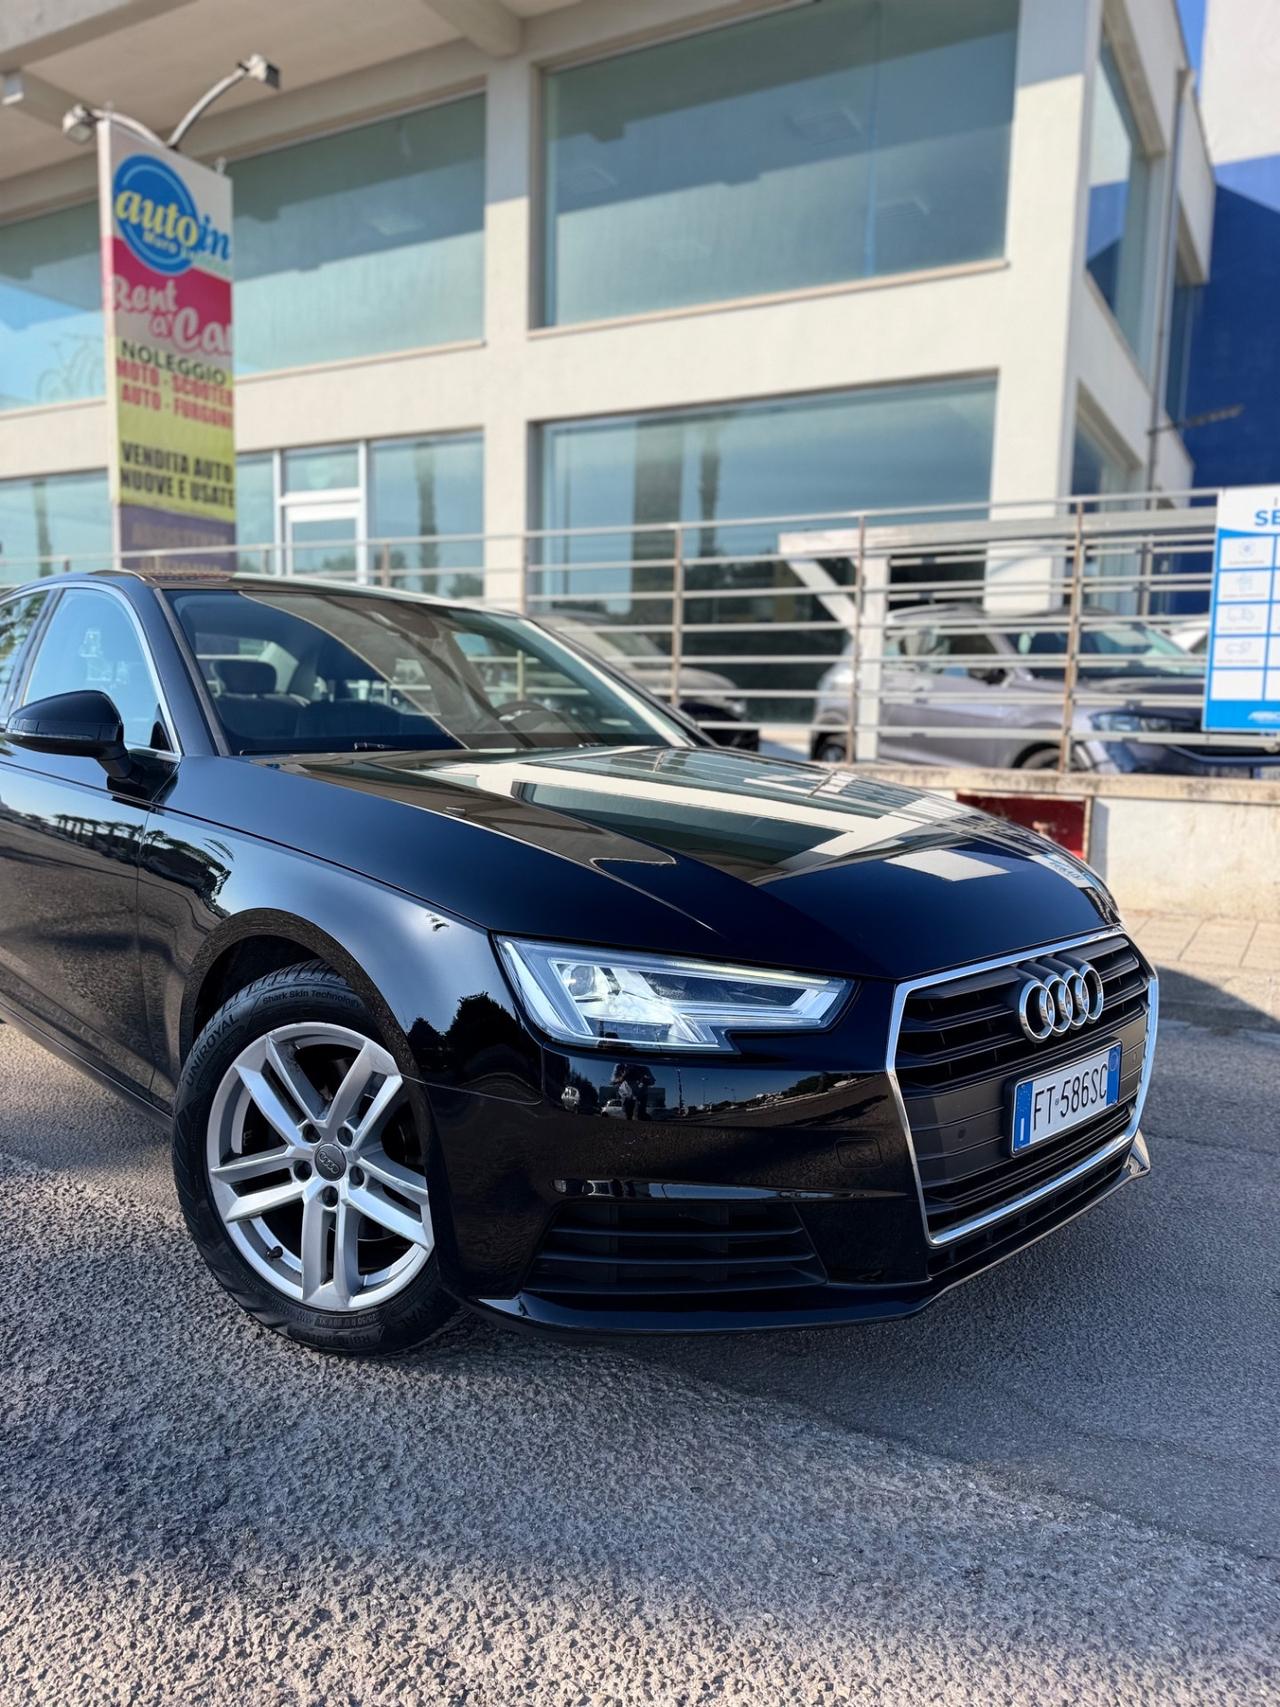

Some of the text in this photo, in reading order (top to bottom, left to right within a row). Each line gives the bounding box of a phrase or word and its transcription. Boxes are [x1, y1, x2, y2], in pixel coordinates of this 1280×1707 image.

[116, 356, 160, 386] MOTO
[121, 340, 227, 385] NOLEGGIO
[121, 383, 162, 411] AUTO
[121, 440, 233, 484] VENDITA AUTO
[121, 467, 234, 508] NUOVE E USATE
[263, 991, 288, 1004] Shark
[289, 989, 309, 998] Skin
[186, 1014, 240, 1086] UNIROYAL
